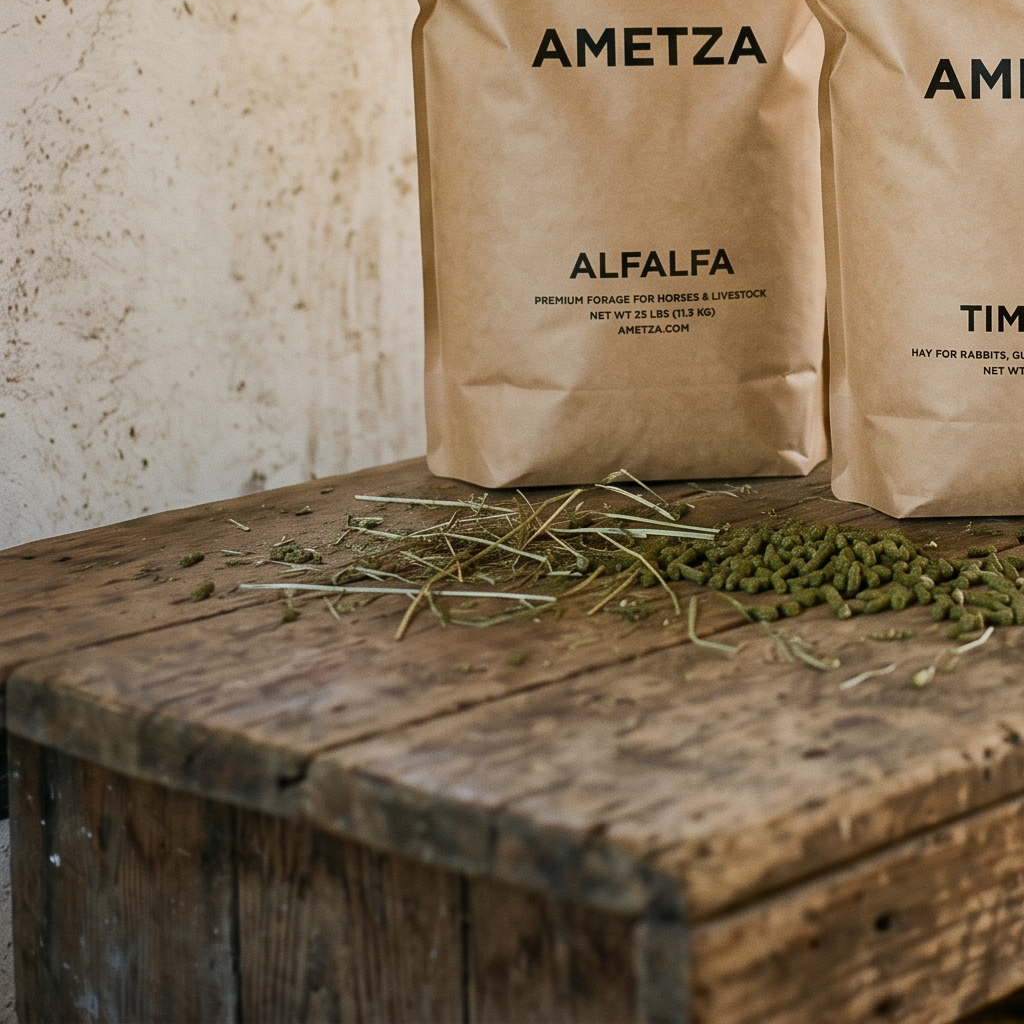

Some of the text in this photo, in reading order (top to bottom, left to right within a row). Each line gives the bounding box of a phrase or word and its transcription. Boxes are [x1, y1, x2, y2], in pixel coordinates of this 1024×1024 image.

[532, 26, 767, 67] AMETZA
[570, 249, 735, 279] ALFALFA
[534, 288, 768, 306] PREMIUM FORAGE FOR HORSES & LIVESTOCK
[589, 307, 717, 321] NET WT 25 LBS (11.3 KG)
[617, 323, 690, 335] AMETZA.COM
[911, 348, 933, 359] HAY
[935, 349, 958, 359] FOR
[960, 349, 1010, 362] RABBITS,
[983, 366, 1006, 376] NET
